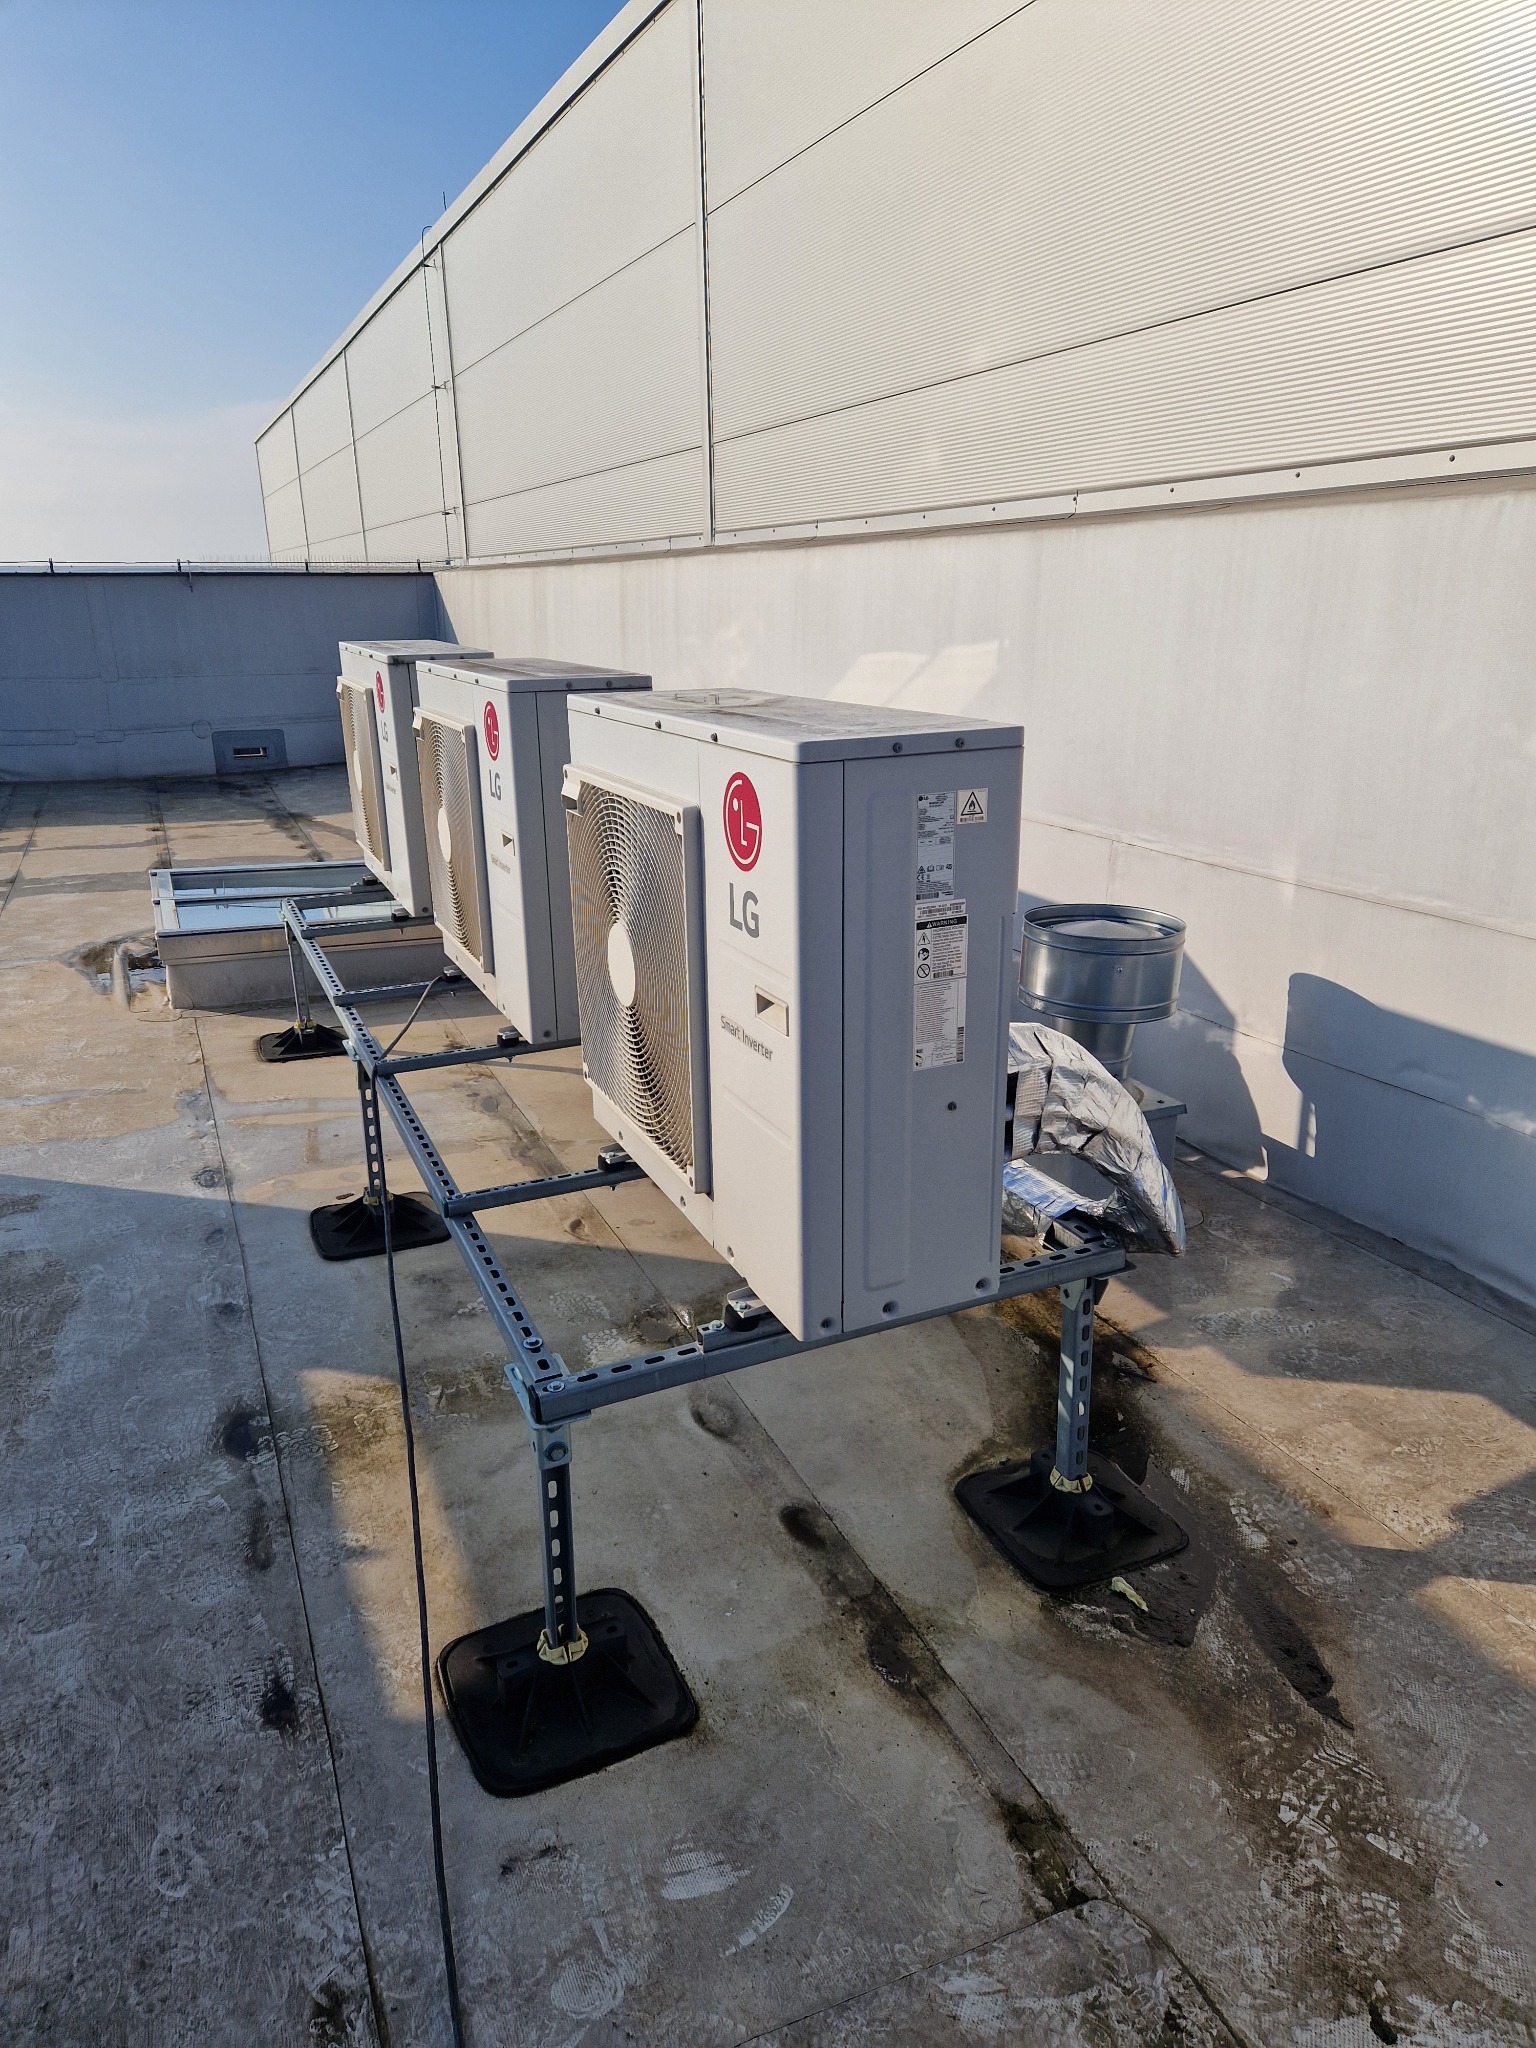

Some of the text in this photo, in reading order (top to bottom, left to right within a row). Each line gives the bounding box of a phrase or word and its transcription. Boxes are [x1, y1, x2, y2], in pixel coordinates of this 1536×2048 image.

[489, 769, 502, 801] LG
[729, 882, 760, 938] LG
[932, 918, 958, 927] WARNING
[721, 1015, 773, 1061] Smart Inverter
